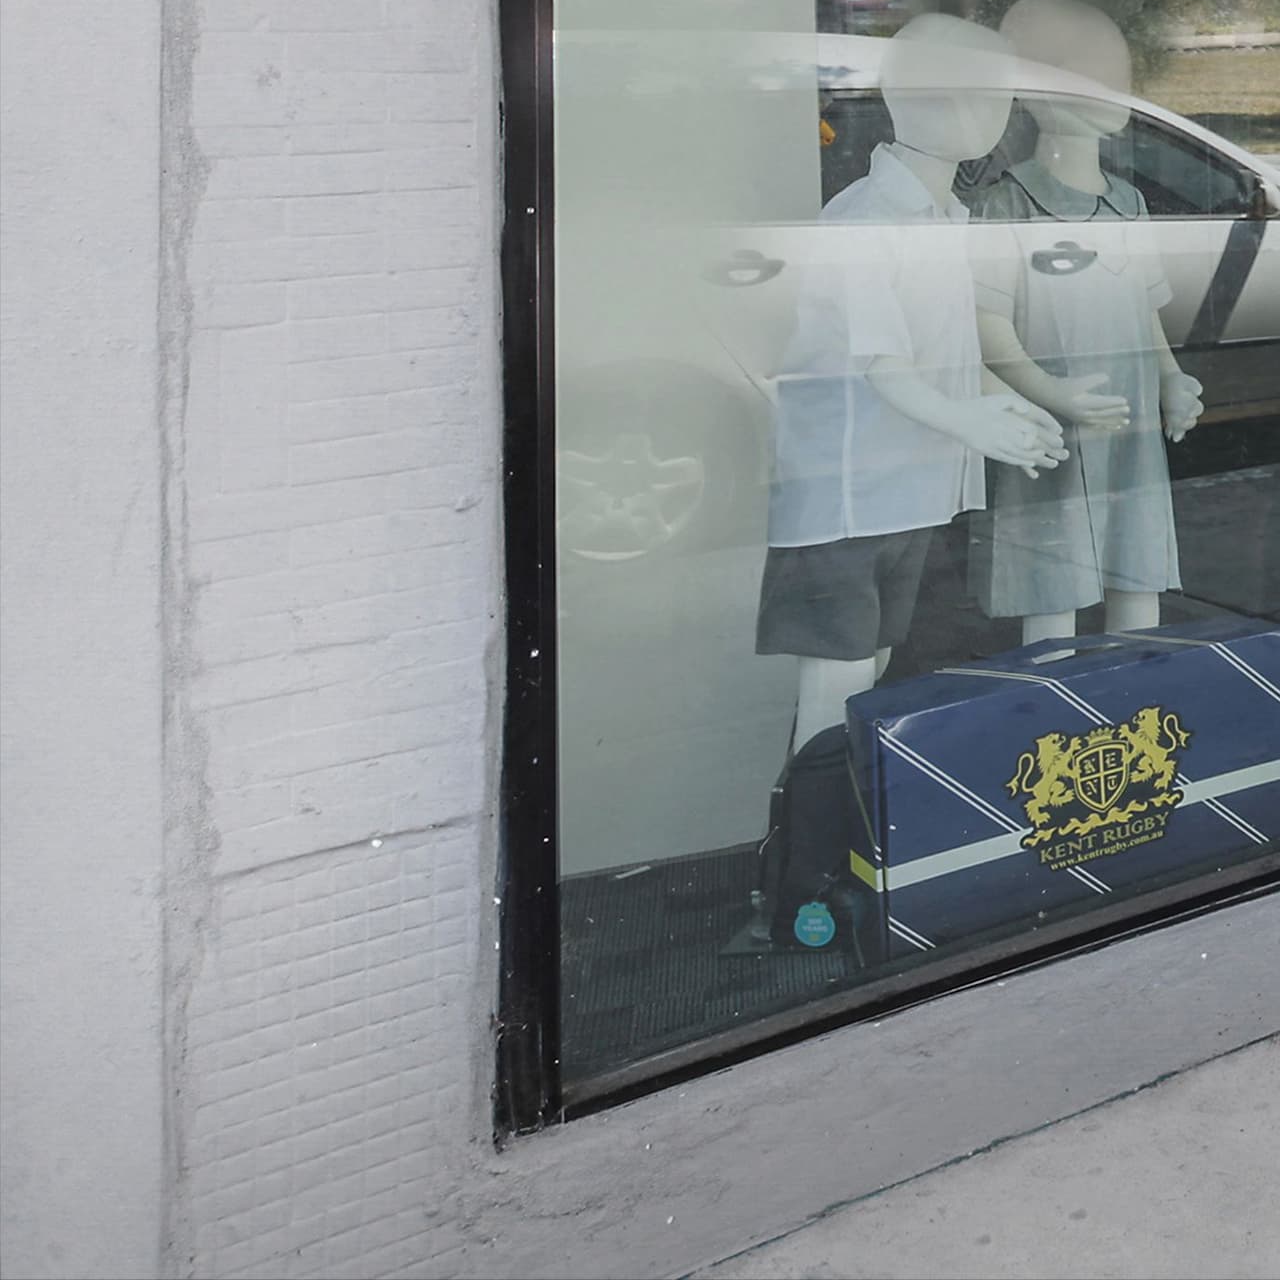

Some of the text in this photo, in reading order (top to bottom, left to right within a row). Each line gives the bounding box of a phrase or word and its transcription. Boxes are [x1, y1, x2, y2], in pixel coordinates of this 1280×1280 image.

[1040, 811, 1169, 863] KENT RUGBY
[1050, 830, 1164, 871] www.kentrugby.com.au
